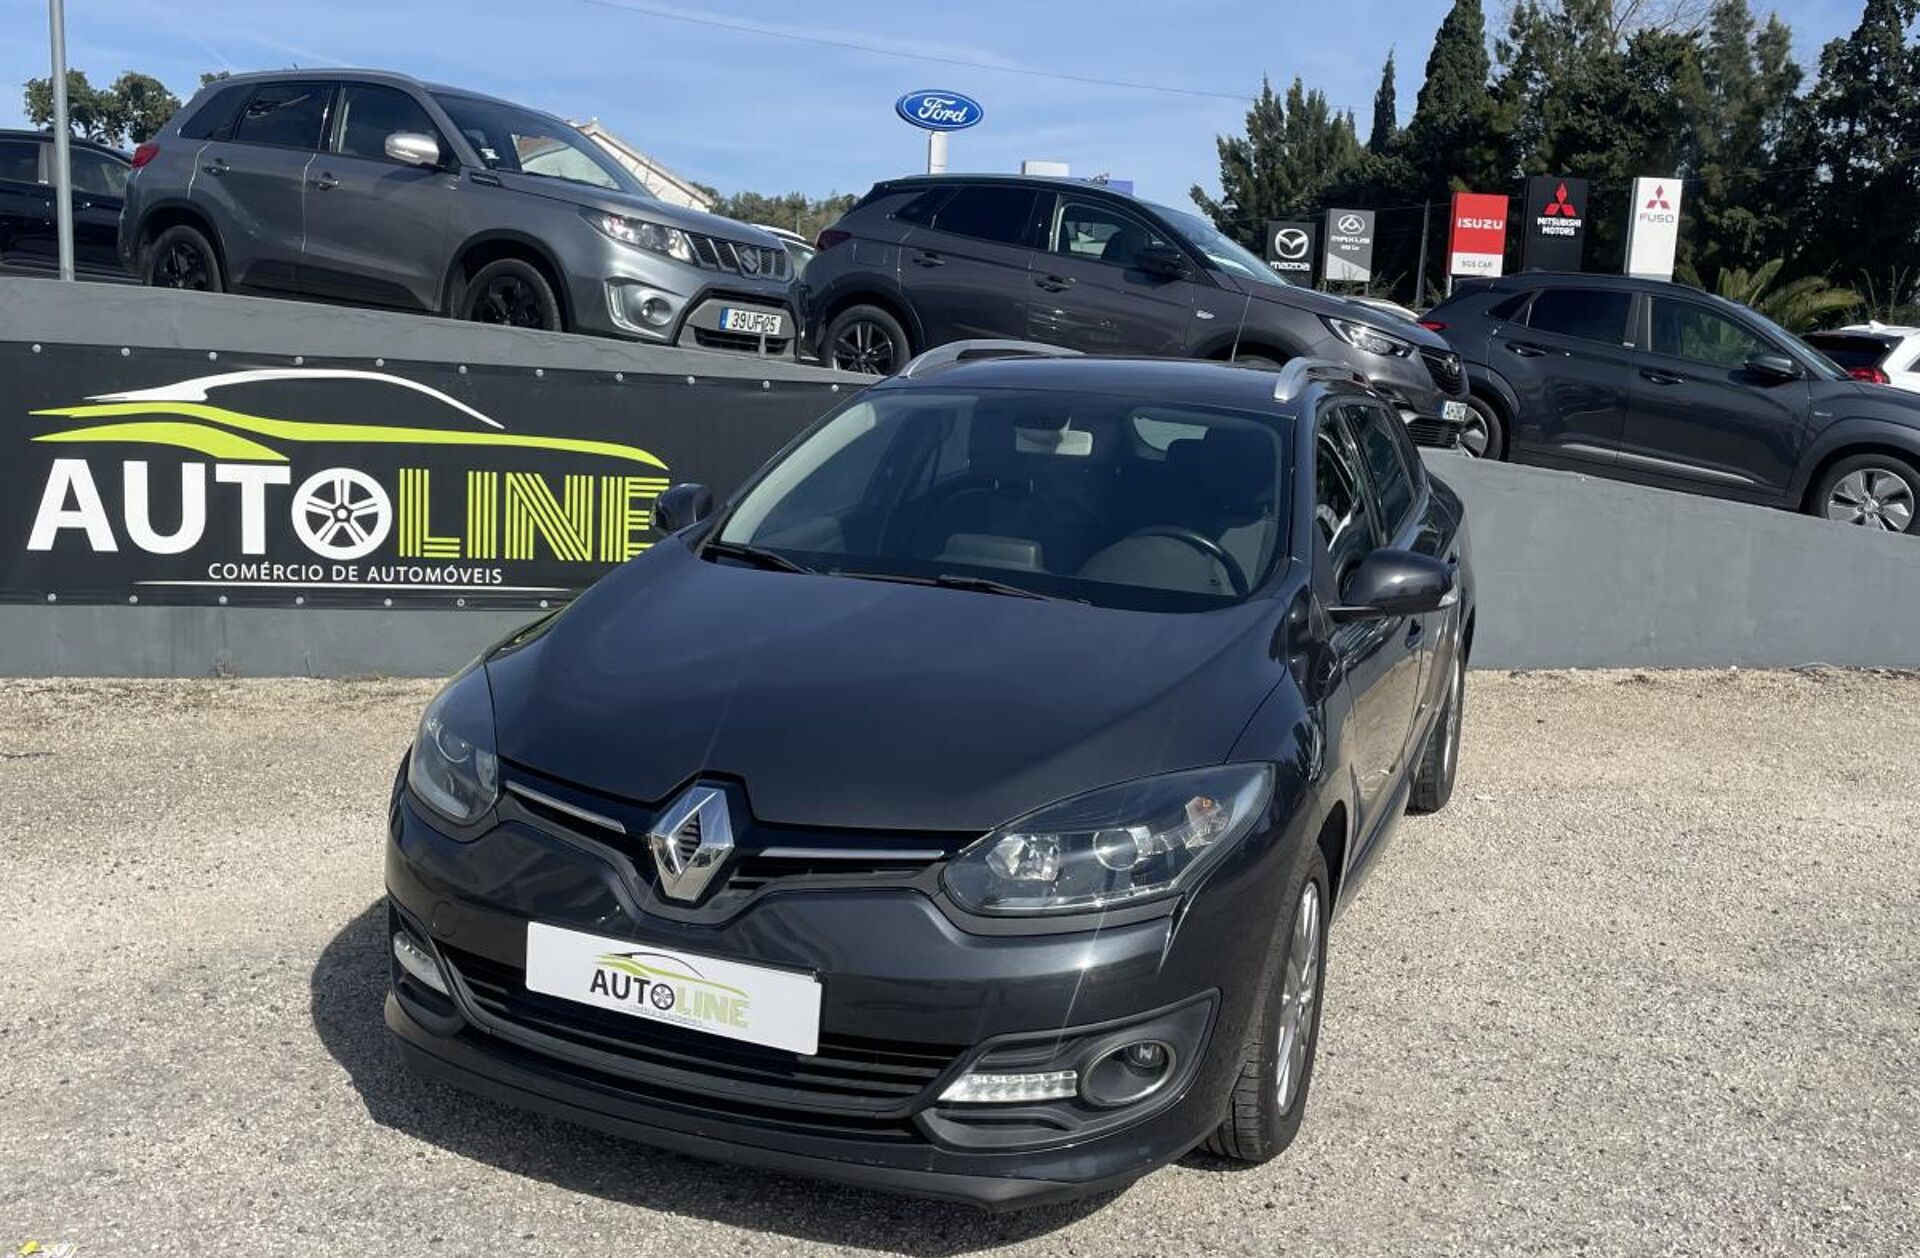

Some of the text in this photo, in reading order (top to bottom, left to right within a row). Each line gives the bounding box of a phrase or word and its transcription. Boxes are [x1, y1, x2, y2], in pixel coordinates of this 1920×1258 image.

[918, 97, 968, 123] Ford
[1457, 217, 1503, 230] ISUZU
[1537, 217, 1582, 228] MITSUBISHI
[1640, 213, 1674, 223] FUSO
[1542, 226, 1576, 236] MOTORS
[1330, 235, 1370, 244] MAXUS
[1270, 261, 1311, 271] mazda
[208, 562, 503, 584] COMÉRCIO DE AUTOMÓVEIS
[589, 968, 750, 1029] AUTOLINE
